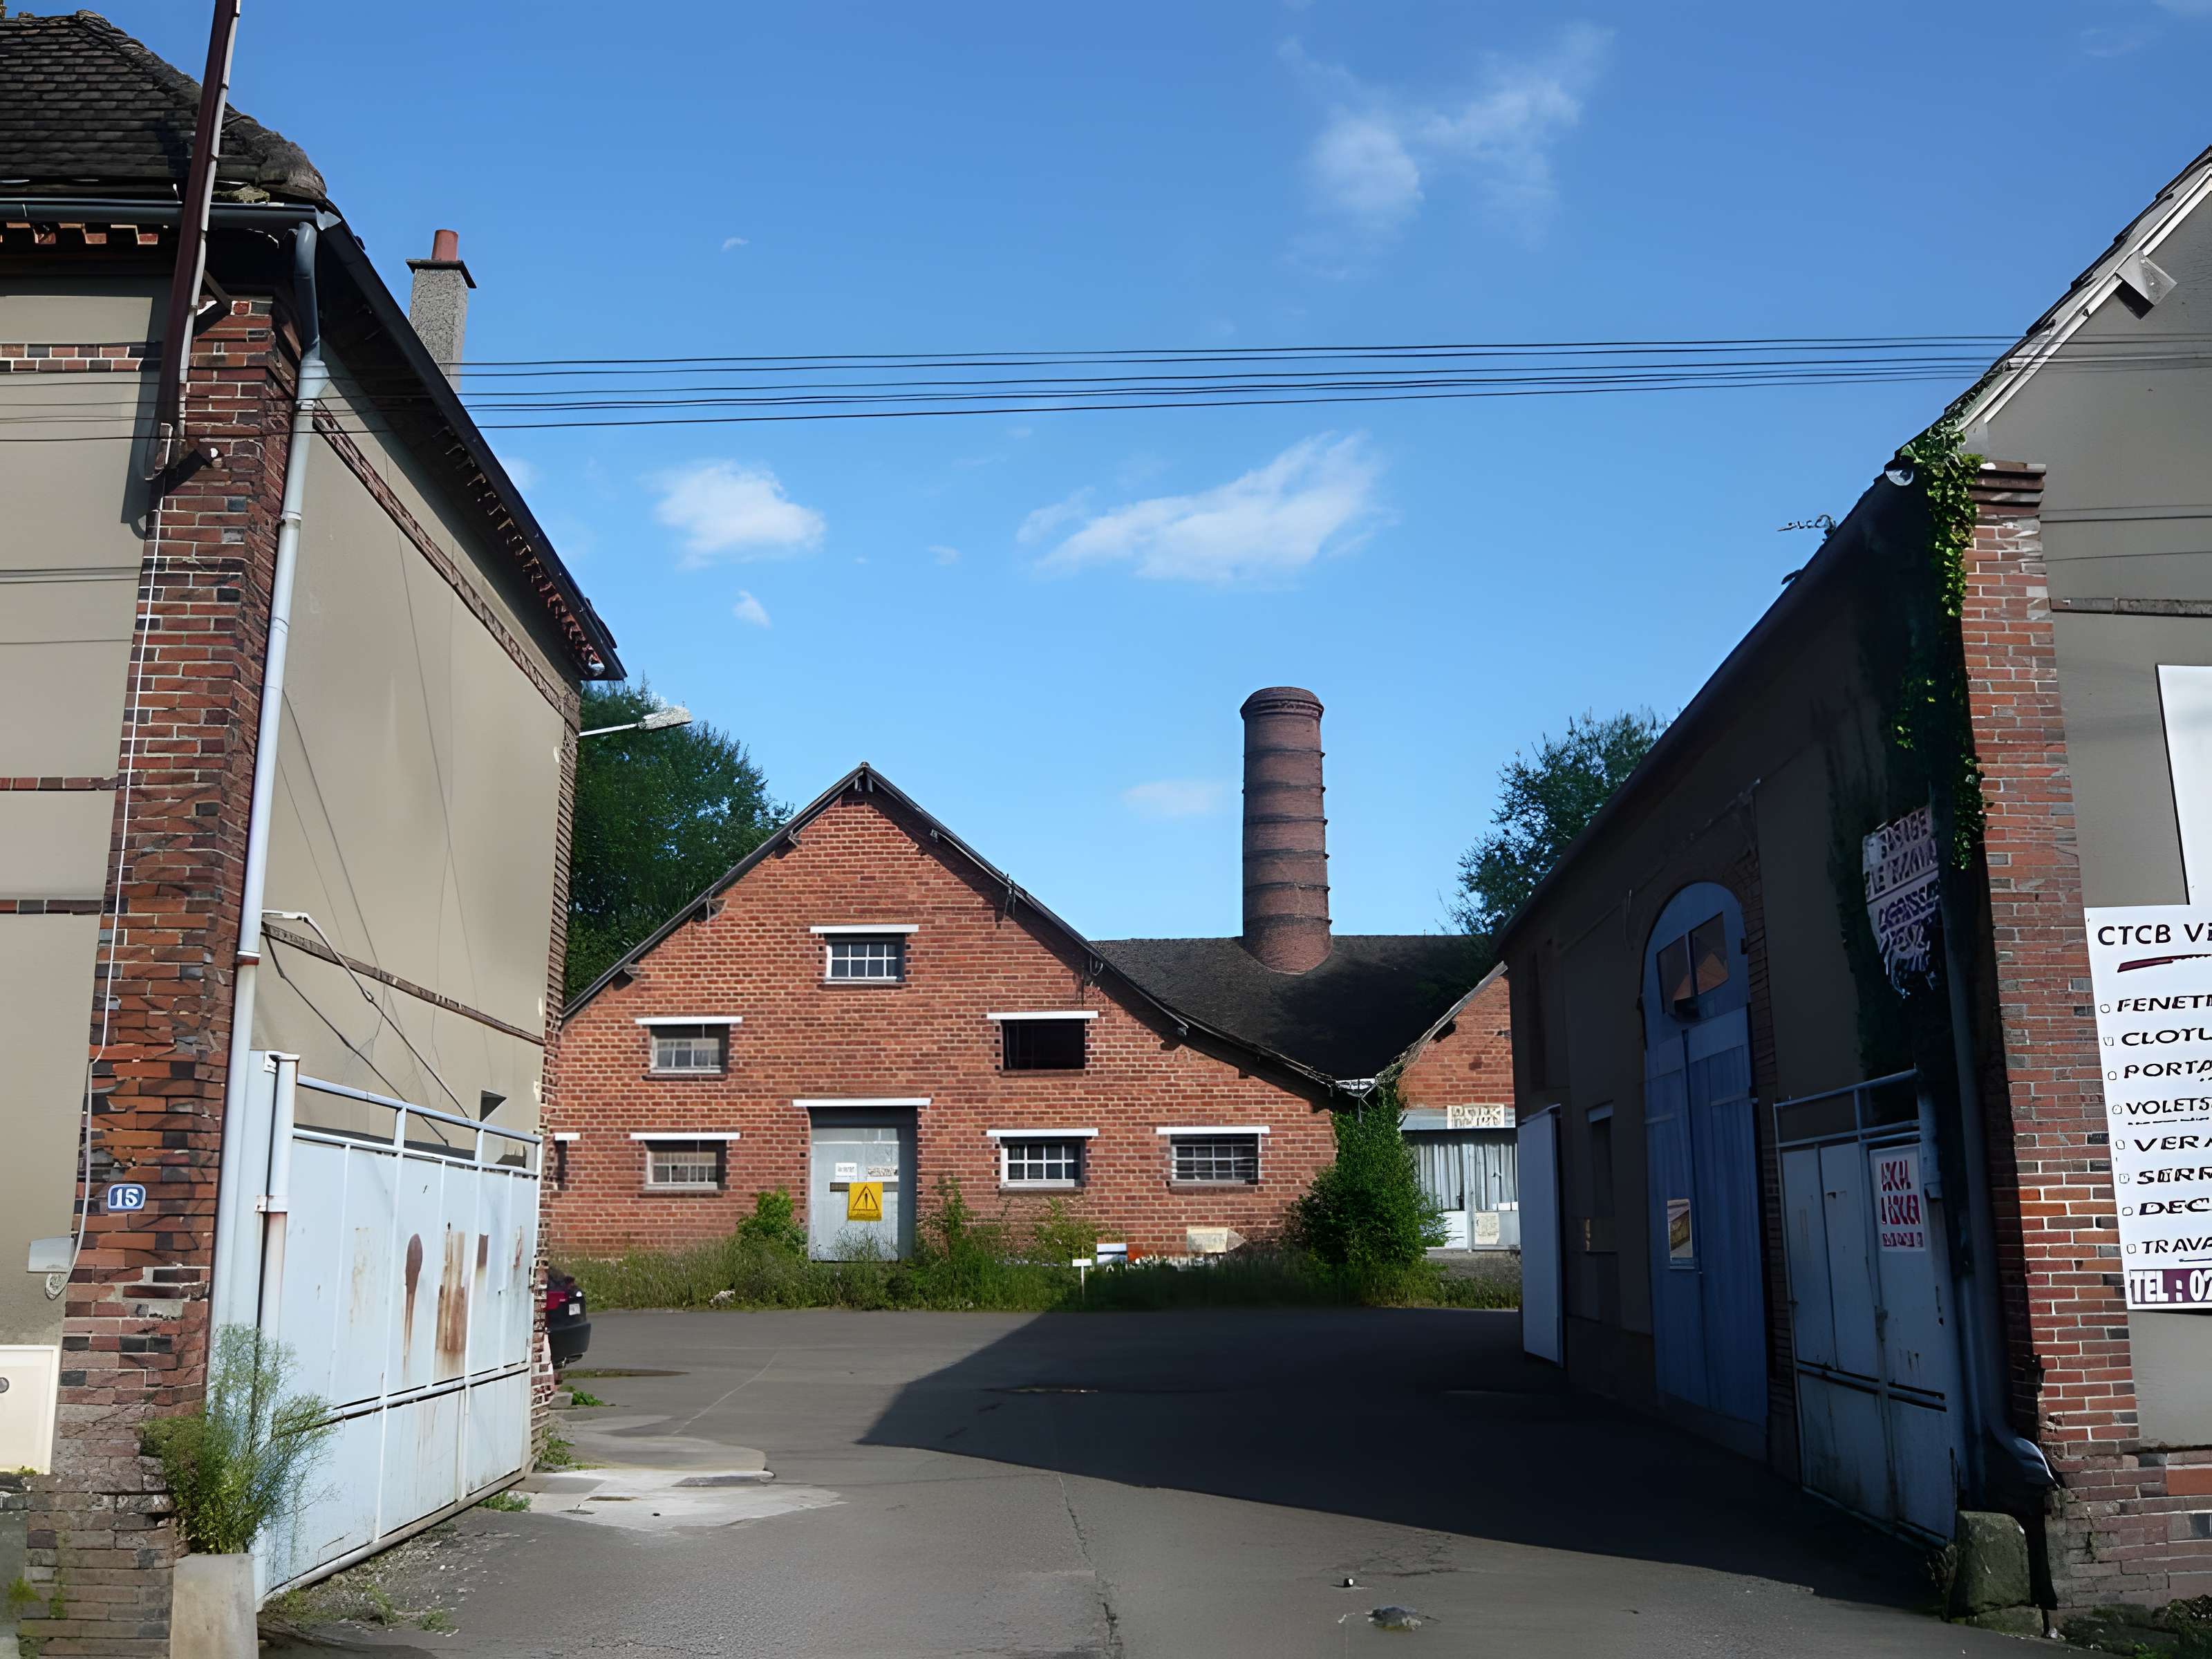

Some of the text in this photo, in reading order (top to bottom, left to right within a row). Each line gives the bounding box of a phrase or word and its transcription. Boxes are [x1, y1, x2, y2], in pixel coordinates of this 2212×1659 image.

[2097, 924, 2171, 946] CTCB
[116, 1188, 139, 1207] 15
[2129, 1270, 2169, 1302] TEL
